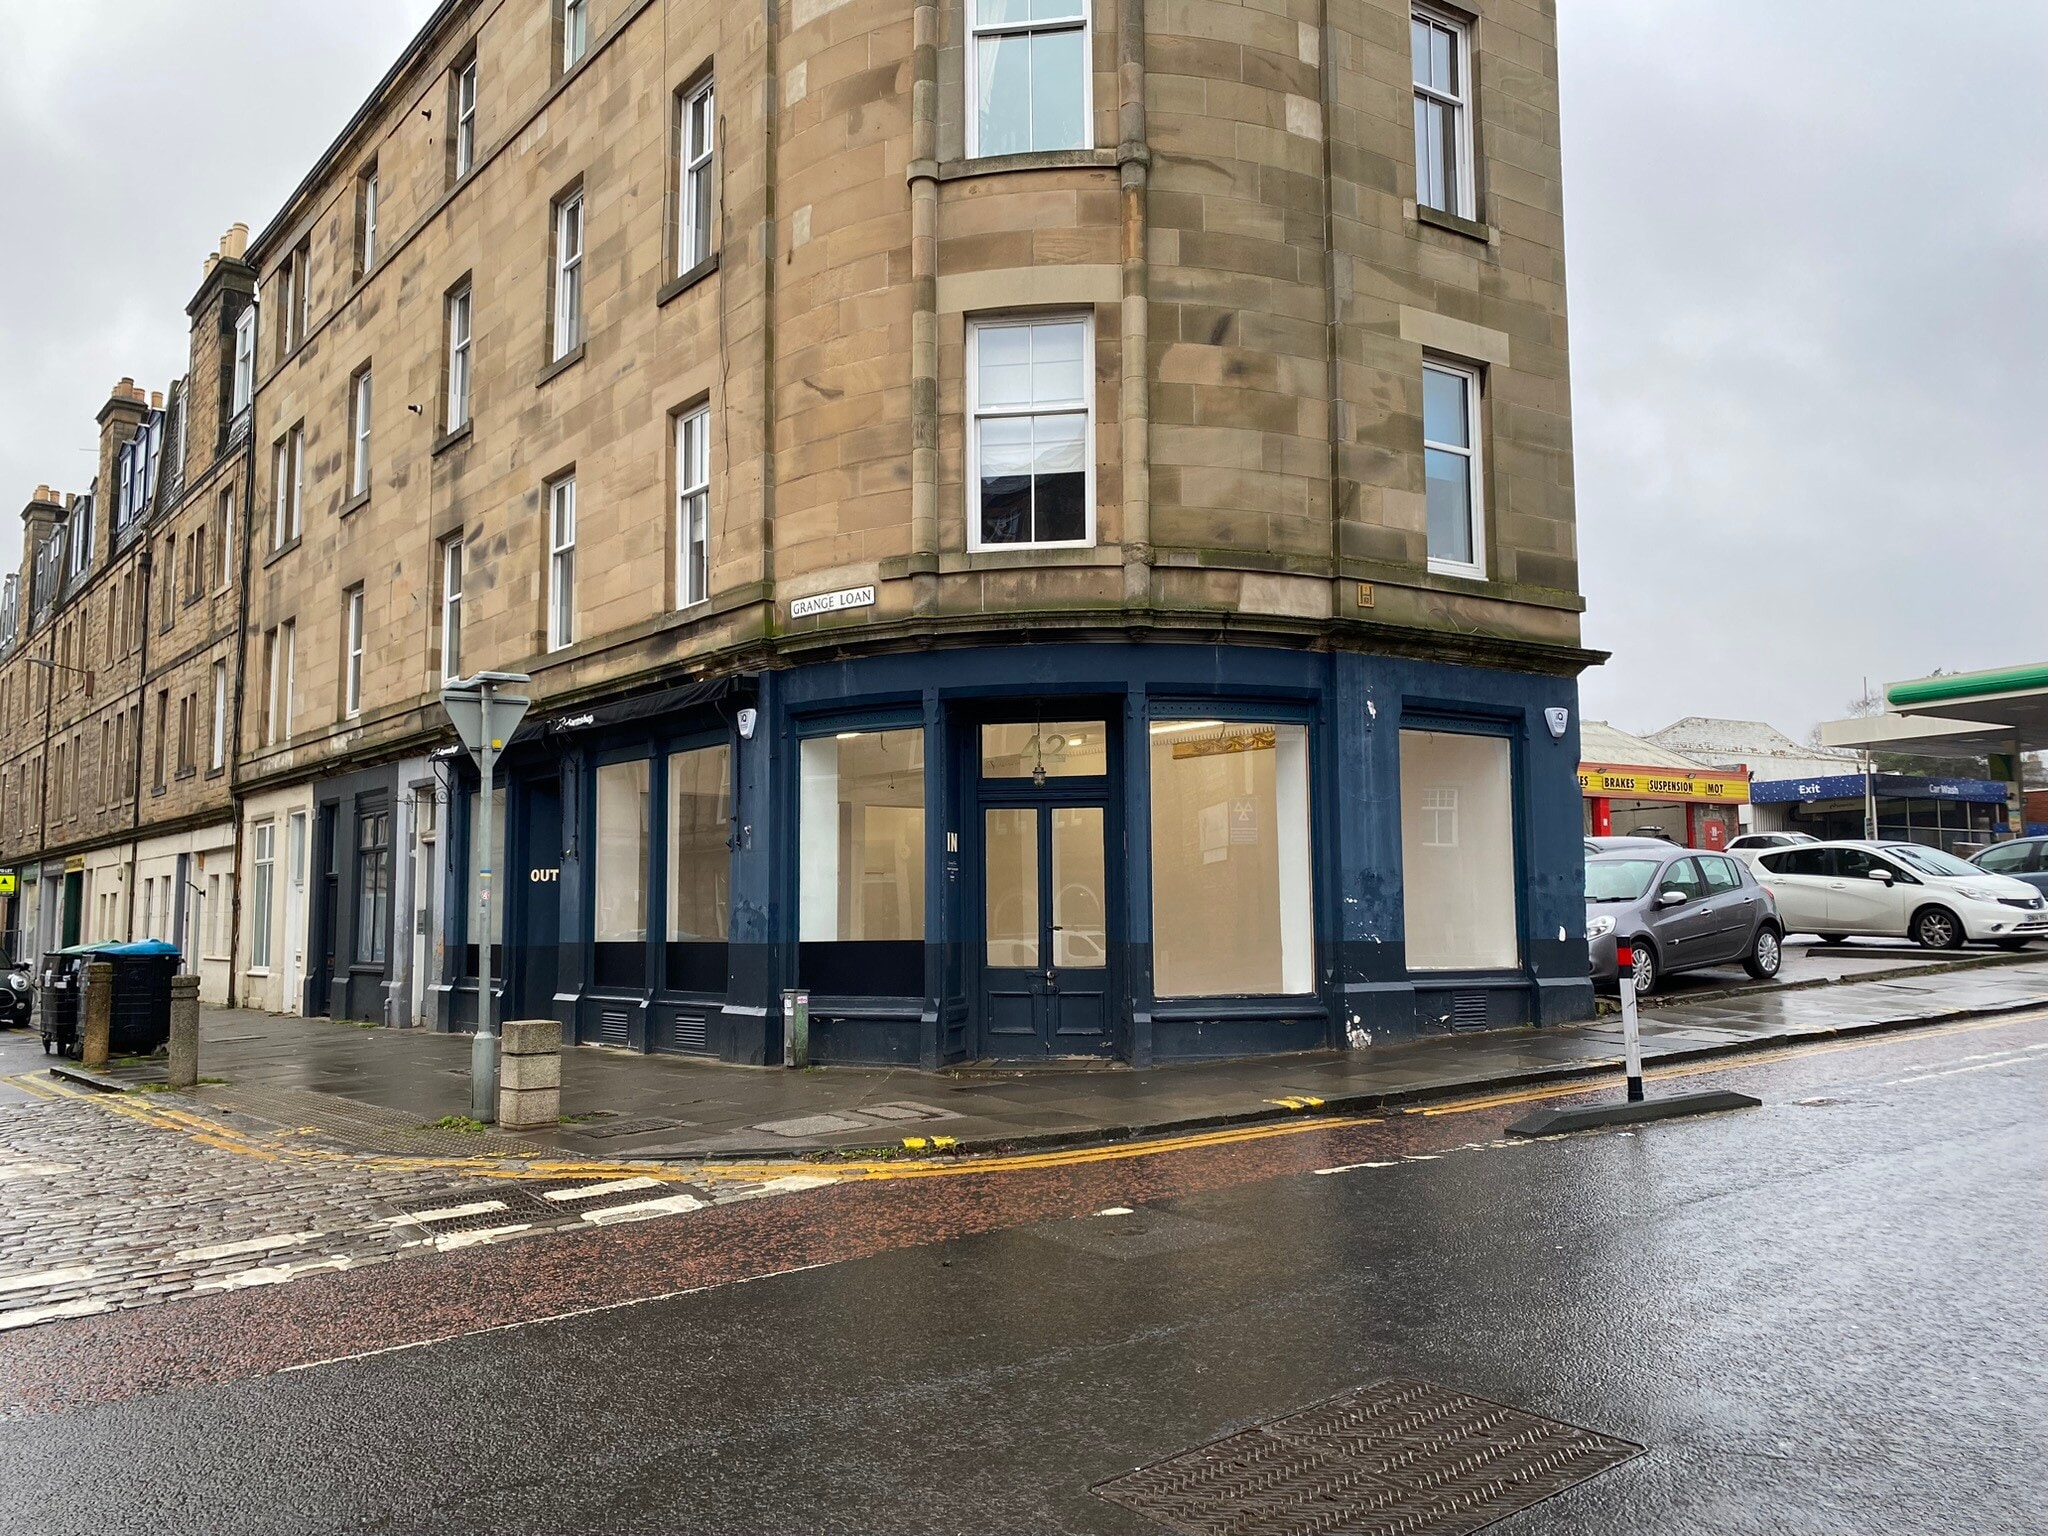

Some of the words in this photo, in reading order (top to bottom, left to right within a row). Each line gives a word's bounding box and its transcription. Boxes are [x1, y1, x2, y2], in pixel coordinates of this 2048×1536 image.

[793, 596, 835, 615] GRANGE
[840, 589, 872, 606] LOAN
[1021, 734, 1066, 763] 42
[1579, 775, 1589, 786] ES
[1604, 777, 1635, 789] BRAKES
[1649, 779, 1694, 792] SUSPENSION
[1707, 783, 1724, 794] MOT
[1799, 783, 1821, 795] Exit
[1929, 783, 1941, 794] Car
[1940, 784, 1960, 795] Wash
[947, 831, 958, 852] IN
[530, 868, 560, 882] OUT
